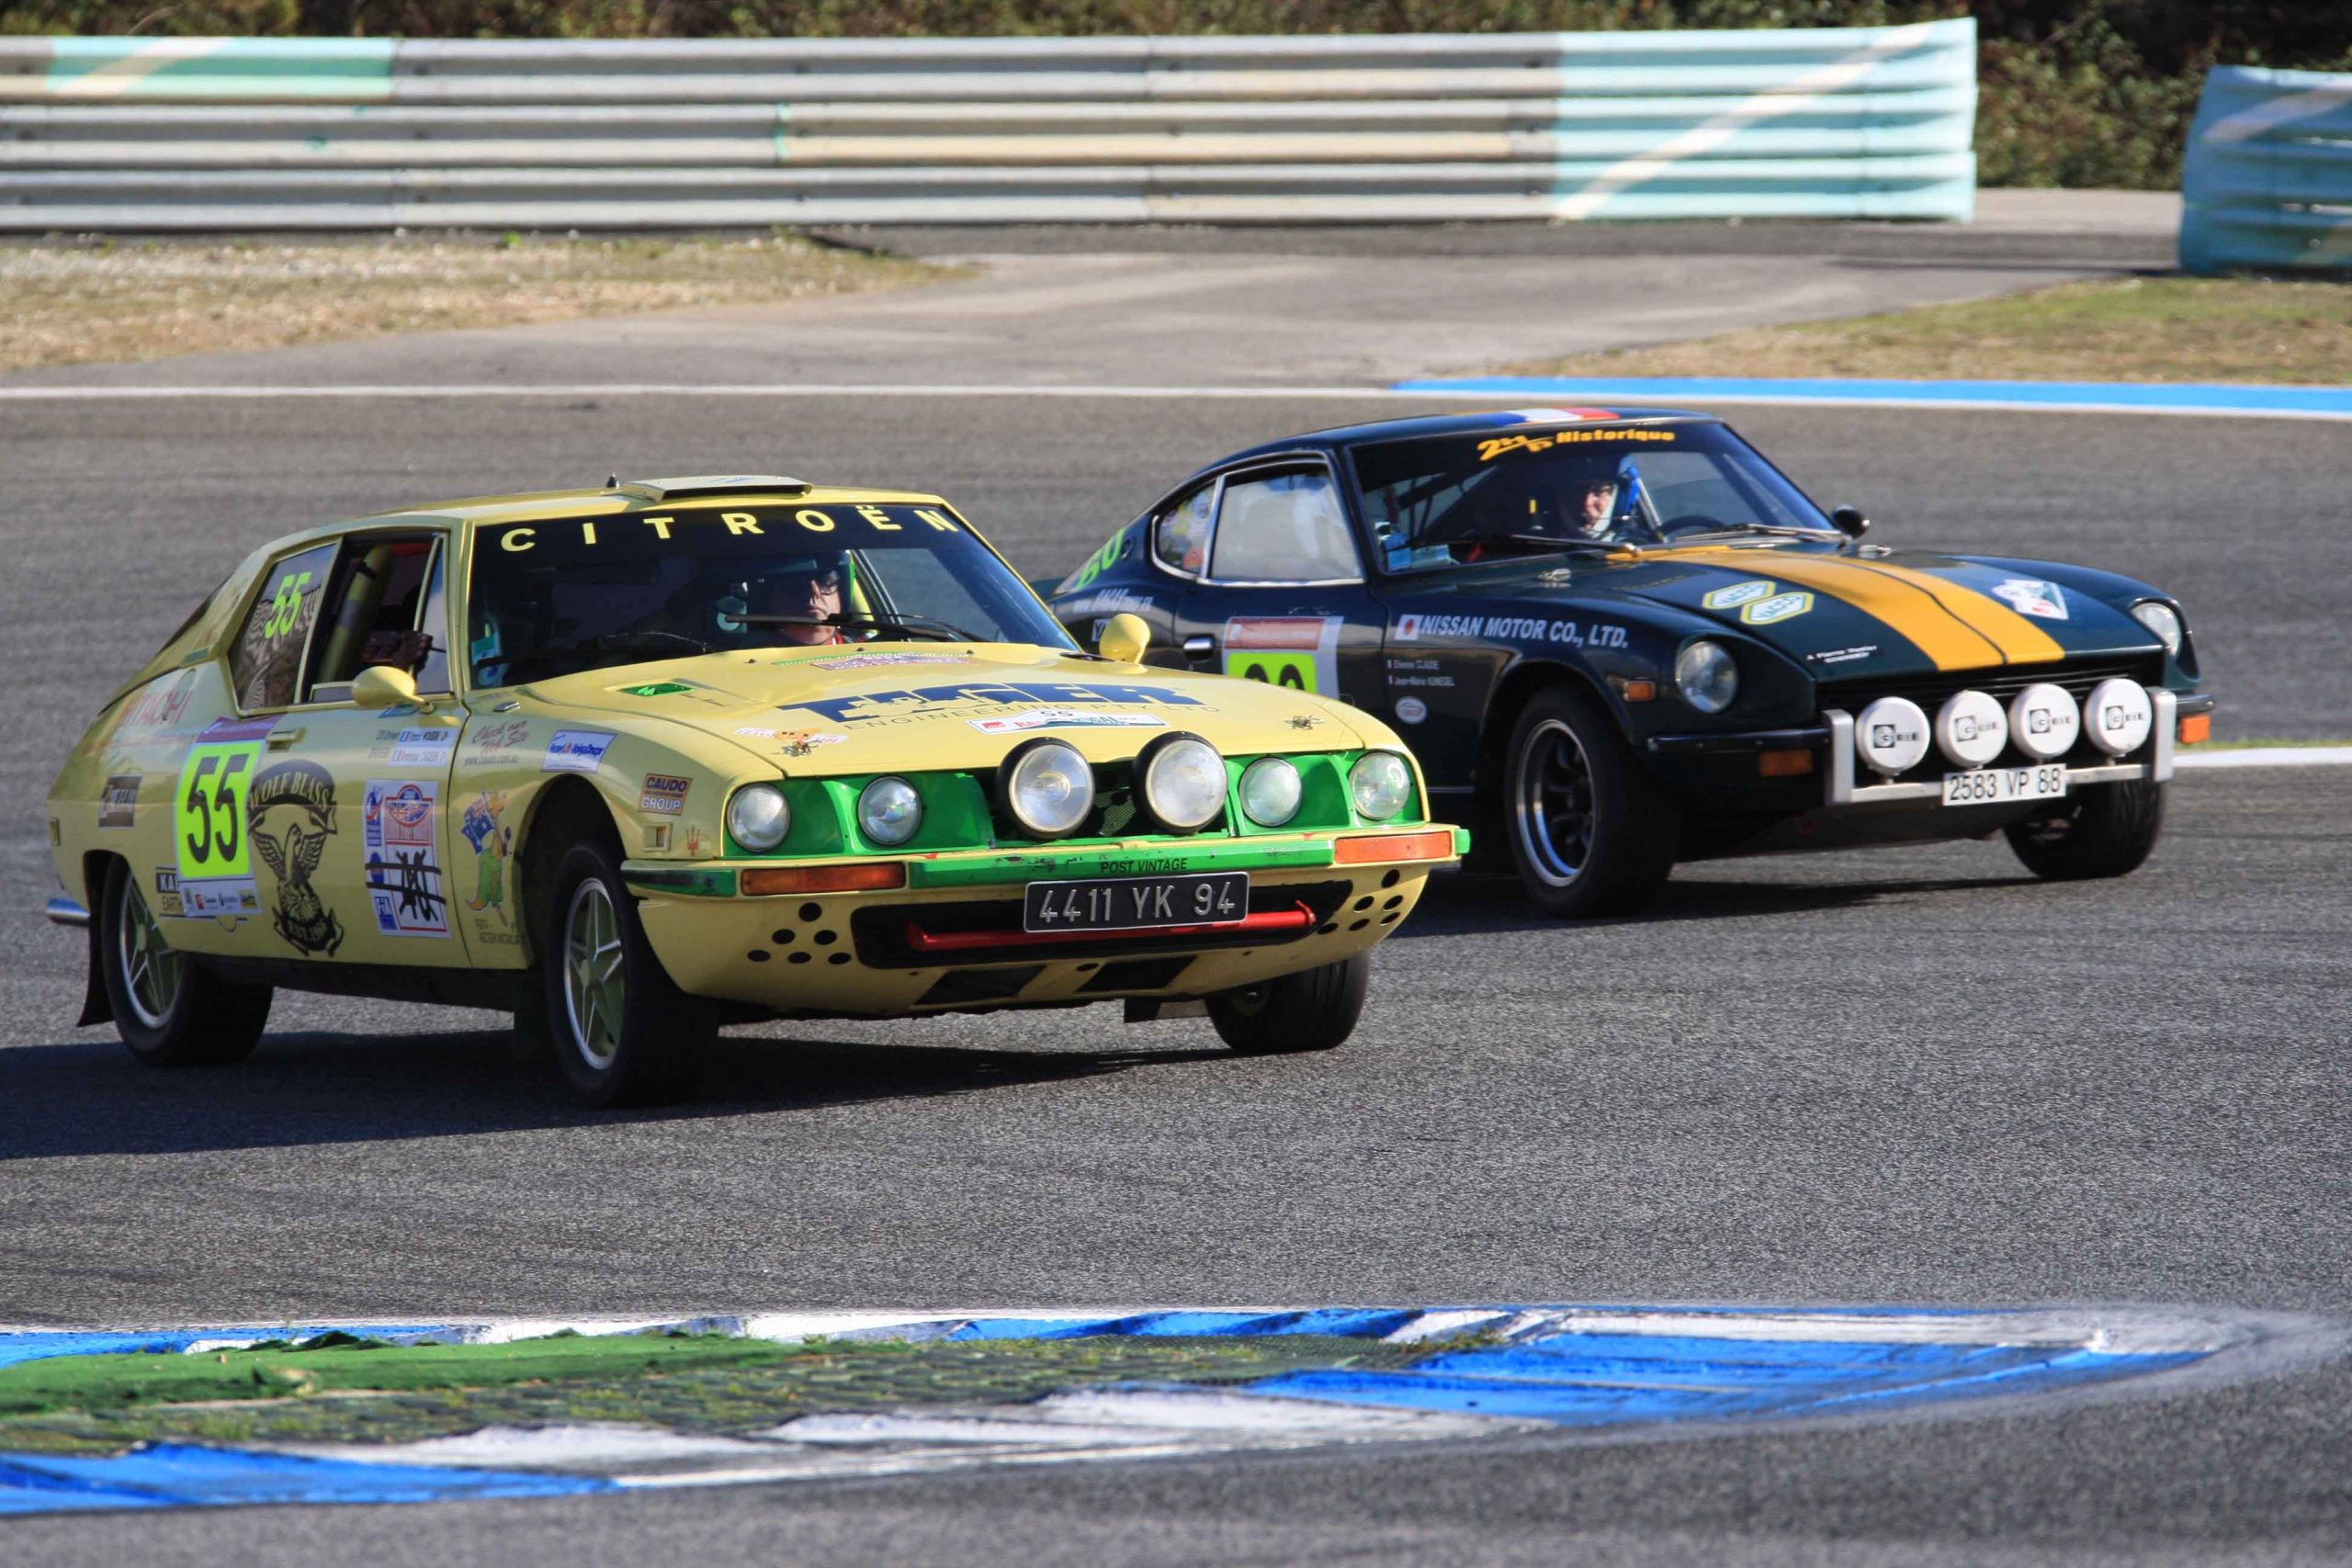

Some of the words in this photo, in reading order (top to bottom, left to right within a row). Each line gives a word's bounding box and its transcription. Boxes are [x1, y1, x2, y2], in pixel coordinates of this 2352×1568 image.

[1555, 429, 1676, 444] Historique
[500, 504, 959, 552] CITROËN
[264, 571, 312, 638] 55
[1419, 615, 1486, 637] NISSAN
[1484, 616, 1548, 641] MOTOR
[1550, 620, 1584, 647] CO.,
[1588, 625, 1629, 649] LTD.
[842, 704, 1076, 731] ENGINEERING
[289, 772, 330, 813] BLASS
[646, 776, 688, 793] CAUDO
[1951, 773, 1997, 801] 2583
[2007, 771, 2028, 796] VP
[2039, 768, 2062, 795] 88
[187, 753, 250, 863] 55
[641, 795, 682, 810] GROUP
[1102, 860, 1134, 874] POST
[1137, 858, 1188, 872] VINTAGE
[1039, 887, 1113, 923] 4411
[1132, 885, 1176, 919] YK
[1193, 882, 1236, 916] 94
